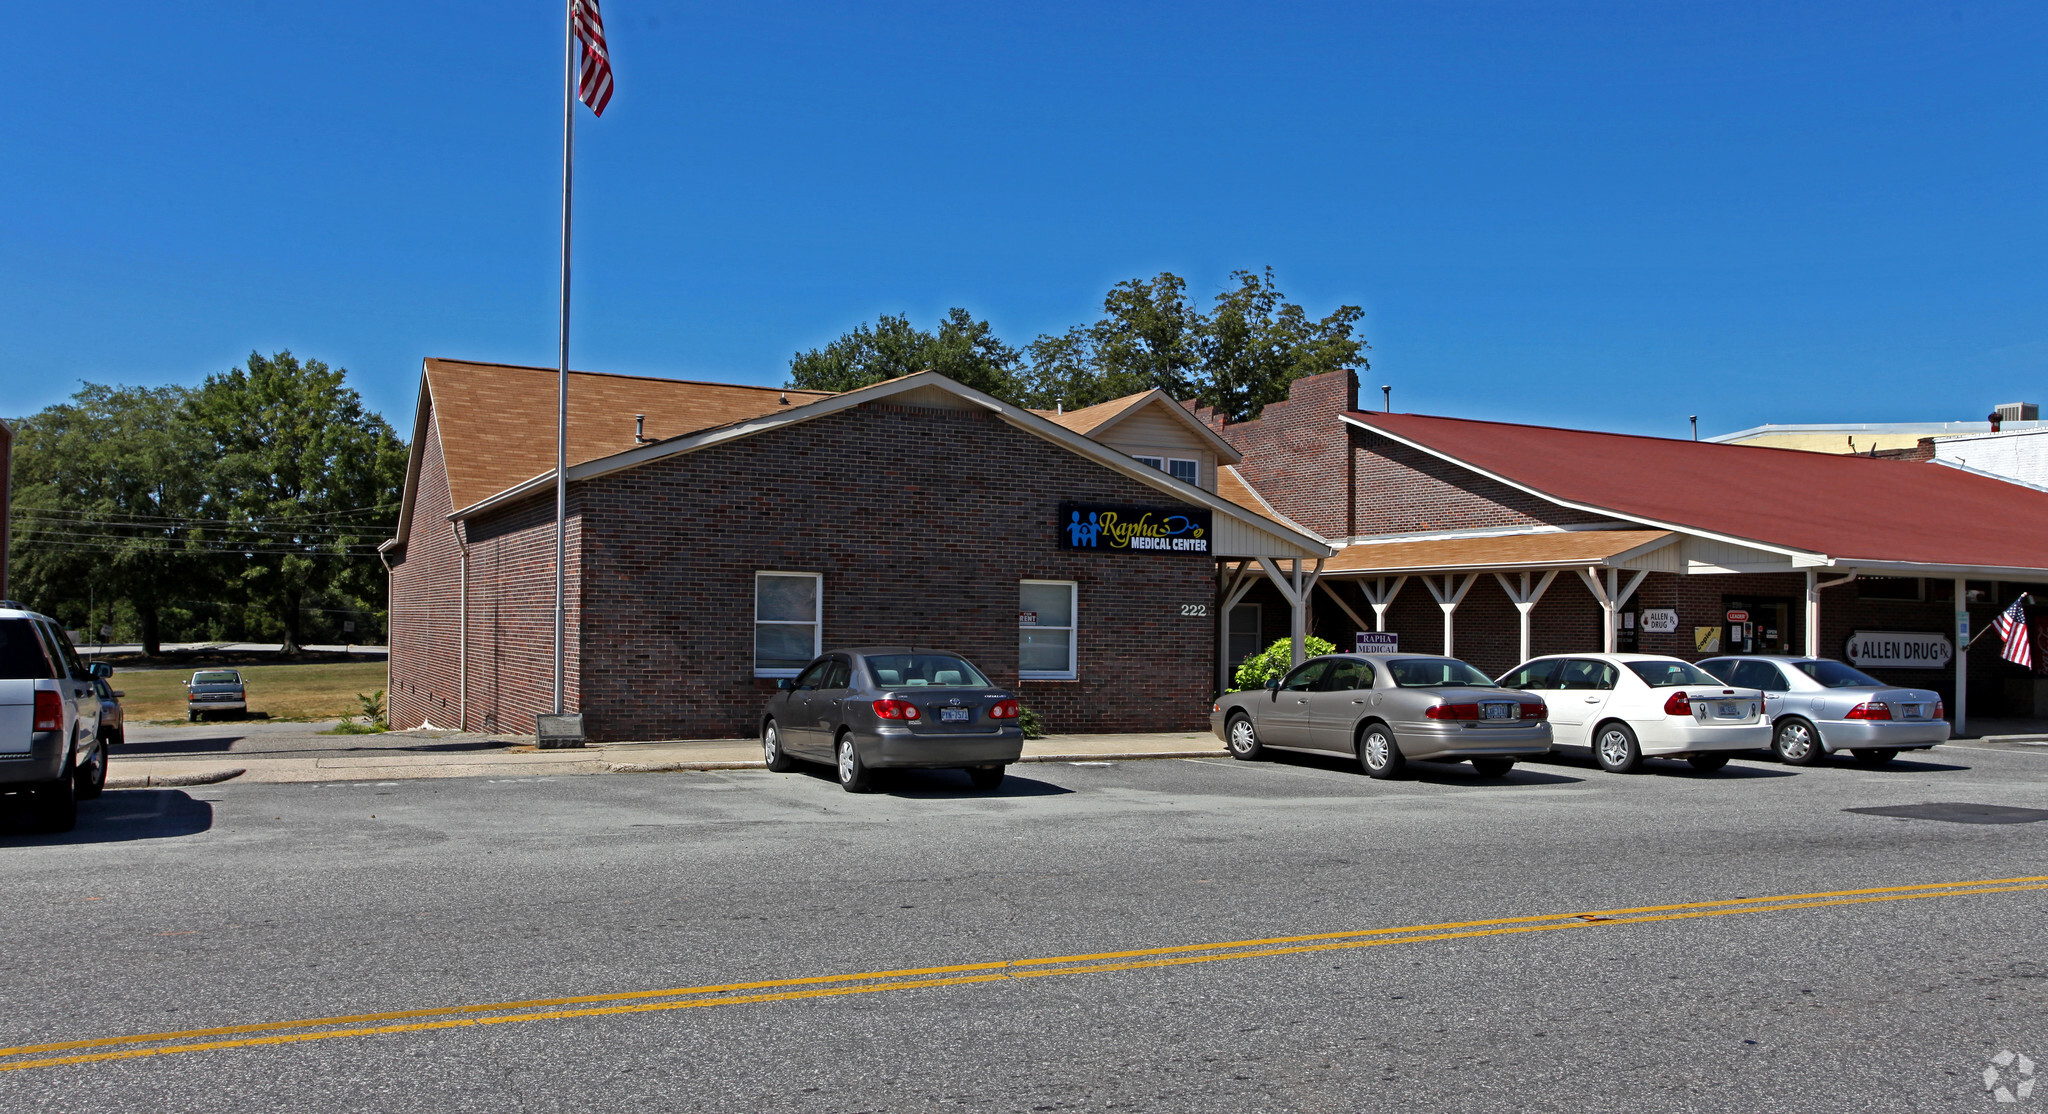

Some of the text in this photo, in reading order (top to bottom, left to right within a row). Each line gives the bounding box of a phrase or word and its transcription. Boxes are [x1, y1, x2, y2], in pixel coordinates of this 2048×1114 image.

[1100, 511, 1170, 548] Rapha
[1131, 536, 1207, 551] MEDICAL CENTER
[1181, 604, 1207, 617] 222
[1650, 612, 1669, 620] ALLEN
[1650, 620, 1668, 629] DRUG
[1363, 634, 1392, 643] RAPHA
[1697, 627, 1715, 651] copies
[1358, 645, 1397, 653] MEDICAL
[1861, 641, 1900, 659] ALLEN
[1904, 641, 1938, 660] DRUG
